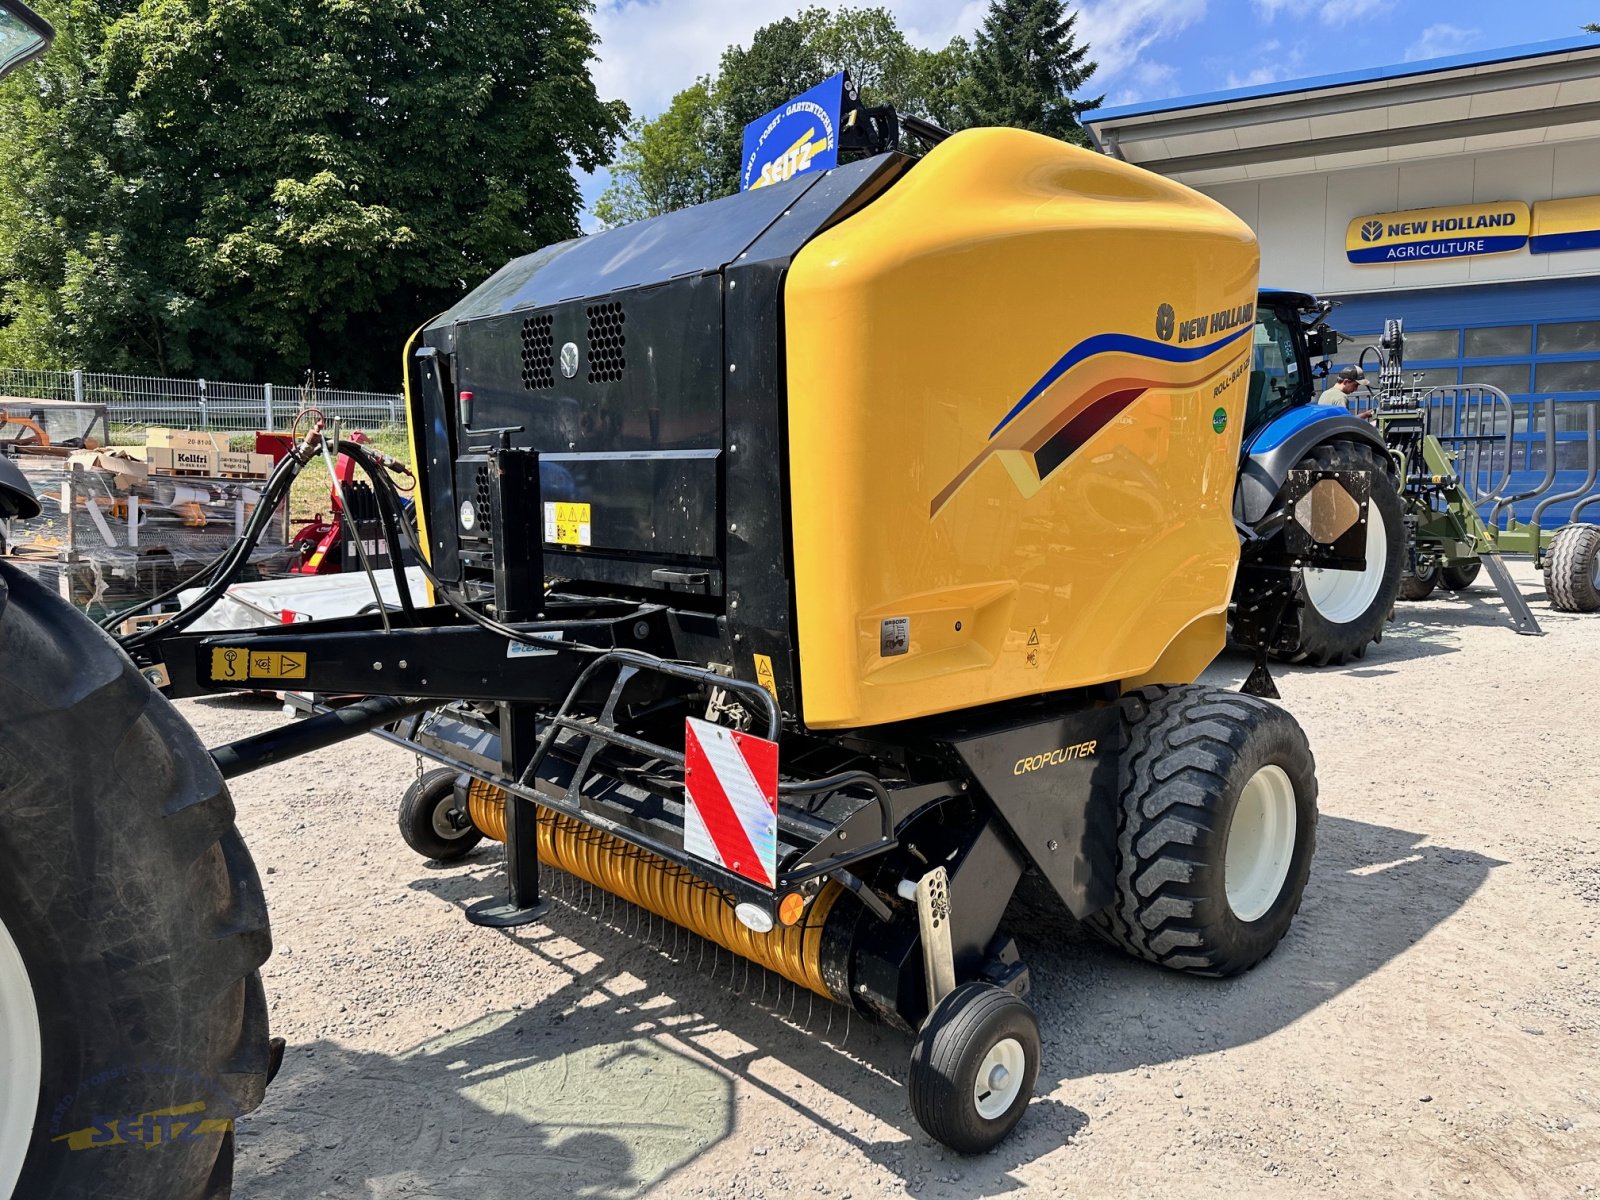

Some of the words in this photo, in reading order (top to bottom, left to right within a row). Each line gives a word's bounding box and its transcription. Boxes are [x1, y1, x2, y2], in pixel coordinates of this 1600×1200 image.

[744, 152, 756, 190] LAND
[759, 113, 781, 147] FORST
[786, 101, 834, 152] GARTENTECHNIK
[761, 142, 812, 188] SEITZ
[1387, 220, 1427, 237] NEW
[1431, 212, 1516, 233] HOLLAND
[1386, 240, 1484, 259] AGRICULTURE
[1178, 315, 1209, 343] NEW
[1210, 303, 1254, 334] HOLLAND
[177, 453, 207, 464] Kellfri
[1013, 739, 1097, 776] CROPCUTTER
